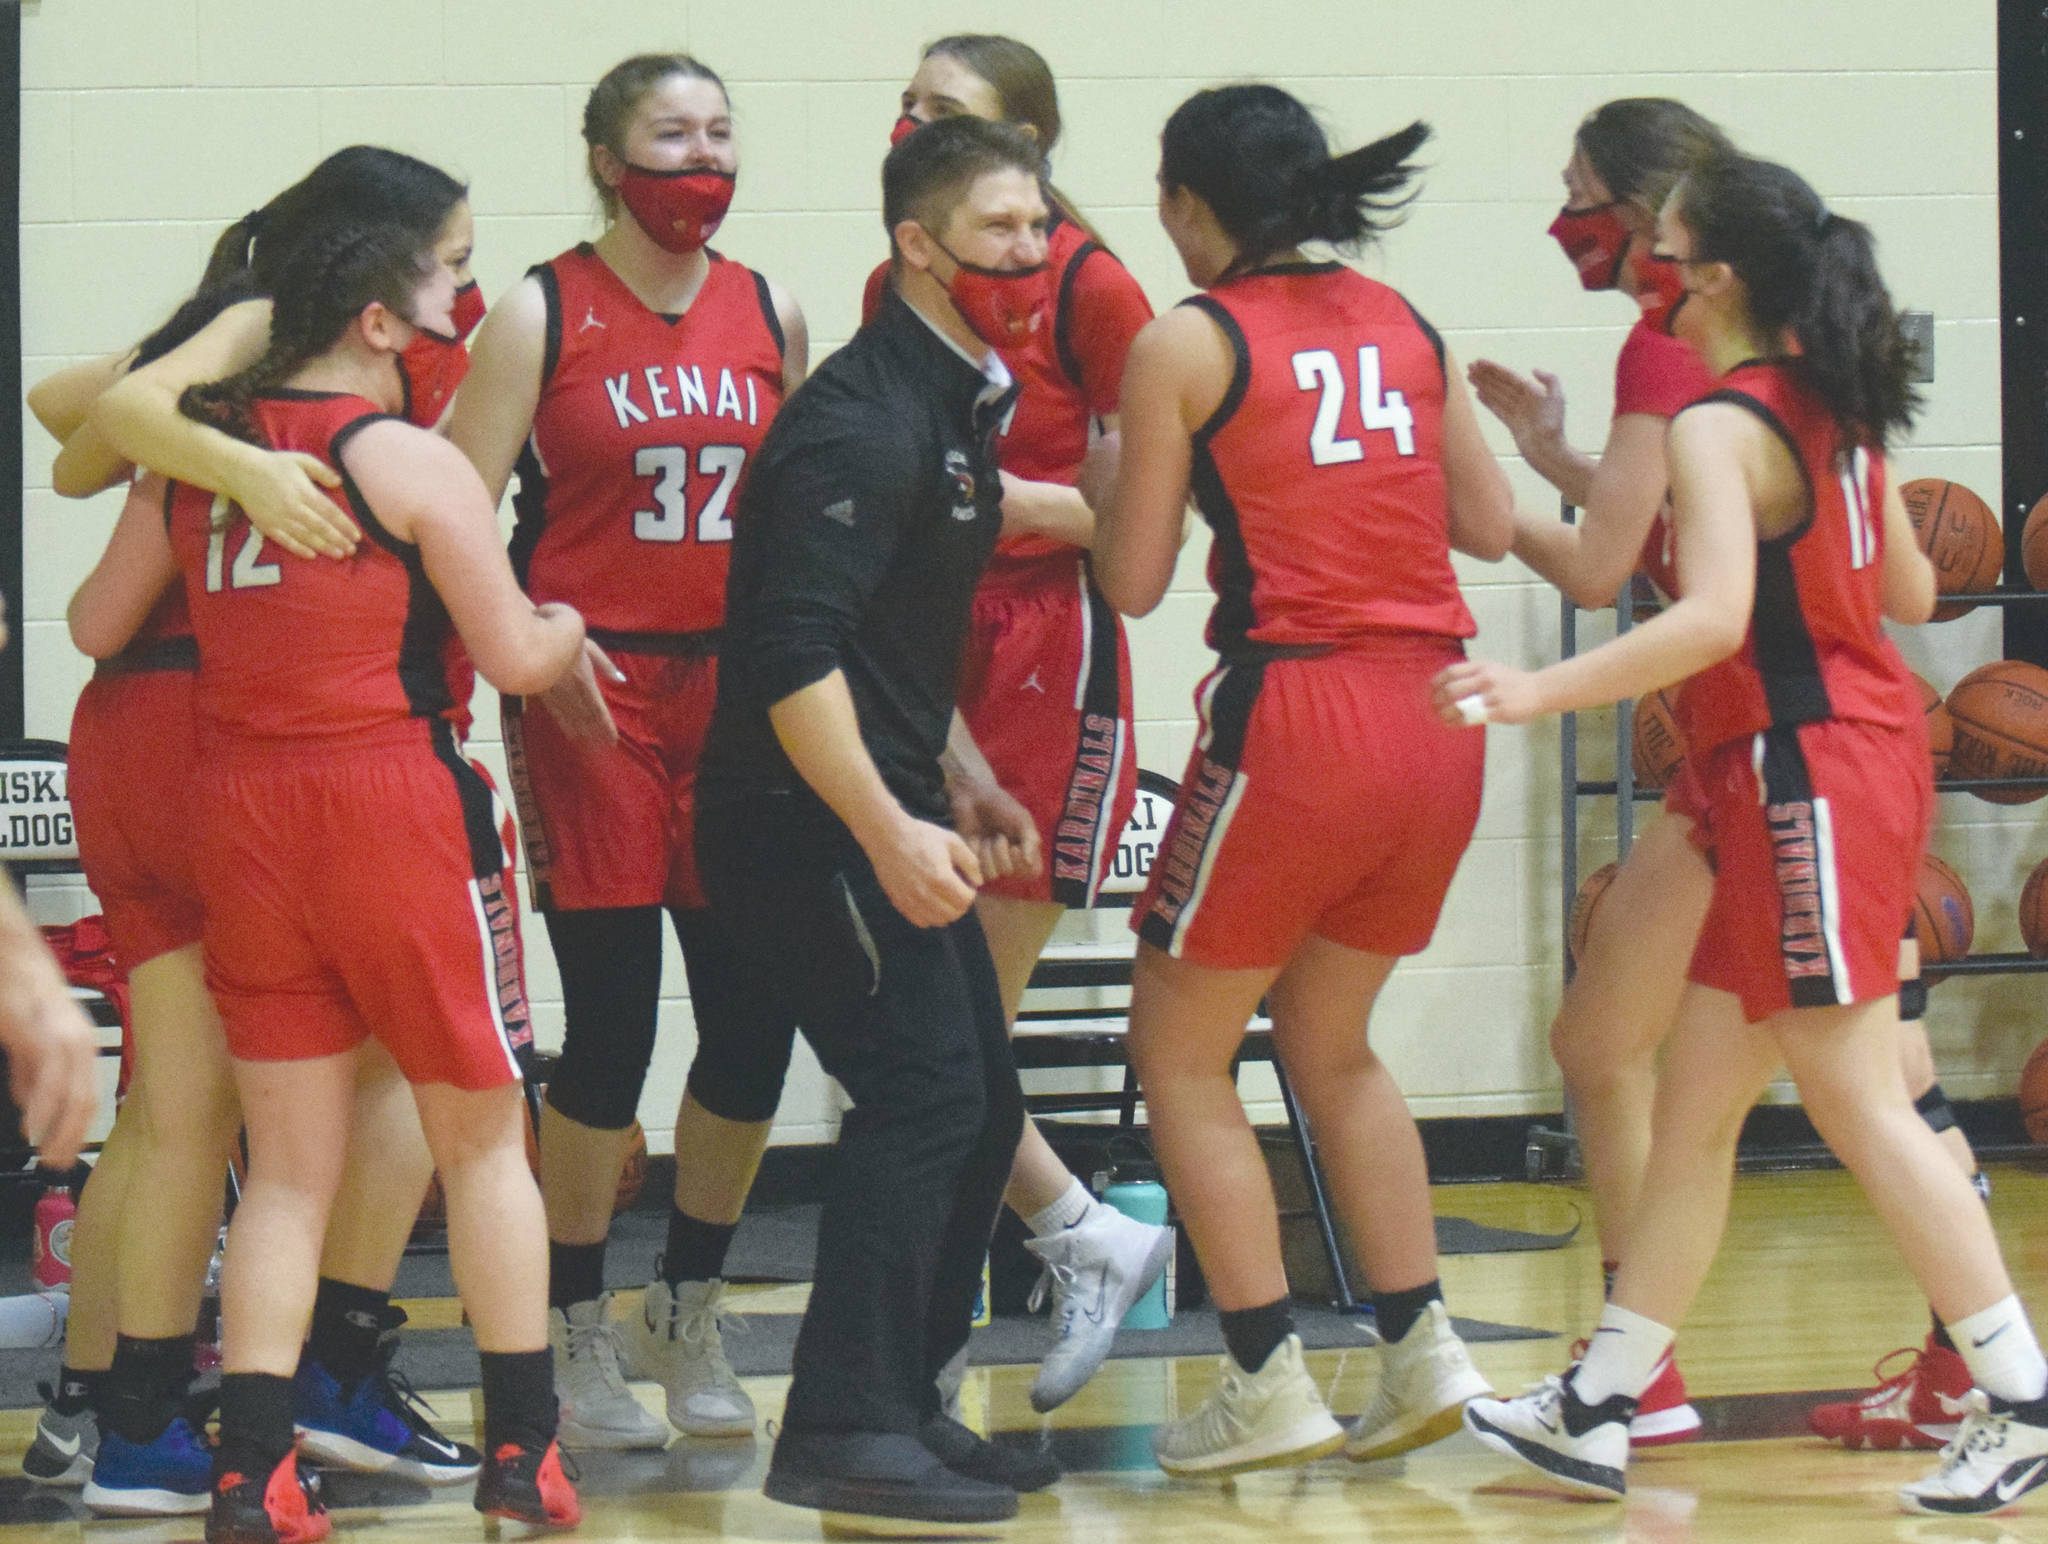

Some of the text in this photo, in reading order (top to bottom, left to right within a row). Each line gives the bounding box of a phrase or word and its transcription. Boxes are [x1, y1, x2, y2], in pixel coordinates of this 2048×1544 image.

[604, 364, 758, 429] KENAI
[1291, 345, 1416, 466] 24
[206, 494, 281, 593] 12
[634, 445, 747, 542] 32
[1055, 713, 1117, 883] KARDINALS
[1154, 758, 1234, 925] KARDINALS
[1105, 843, 1155, 878] OG
[1767, 801, 1831, 979] KARDINALS
